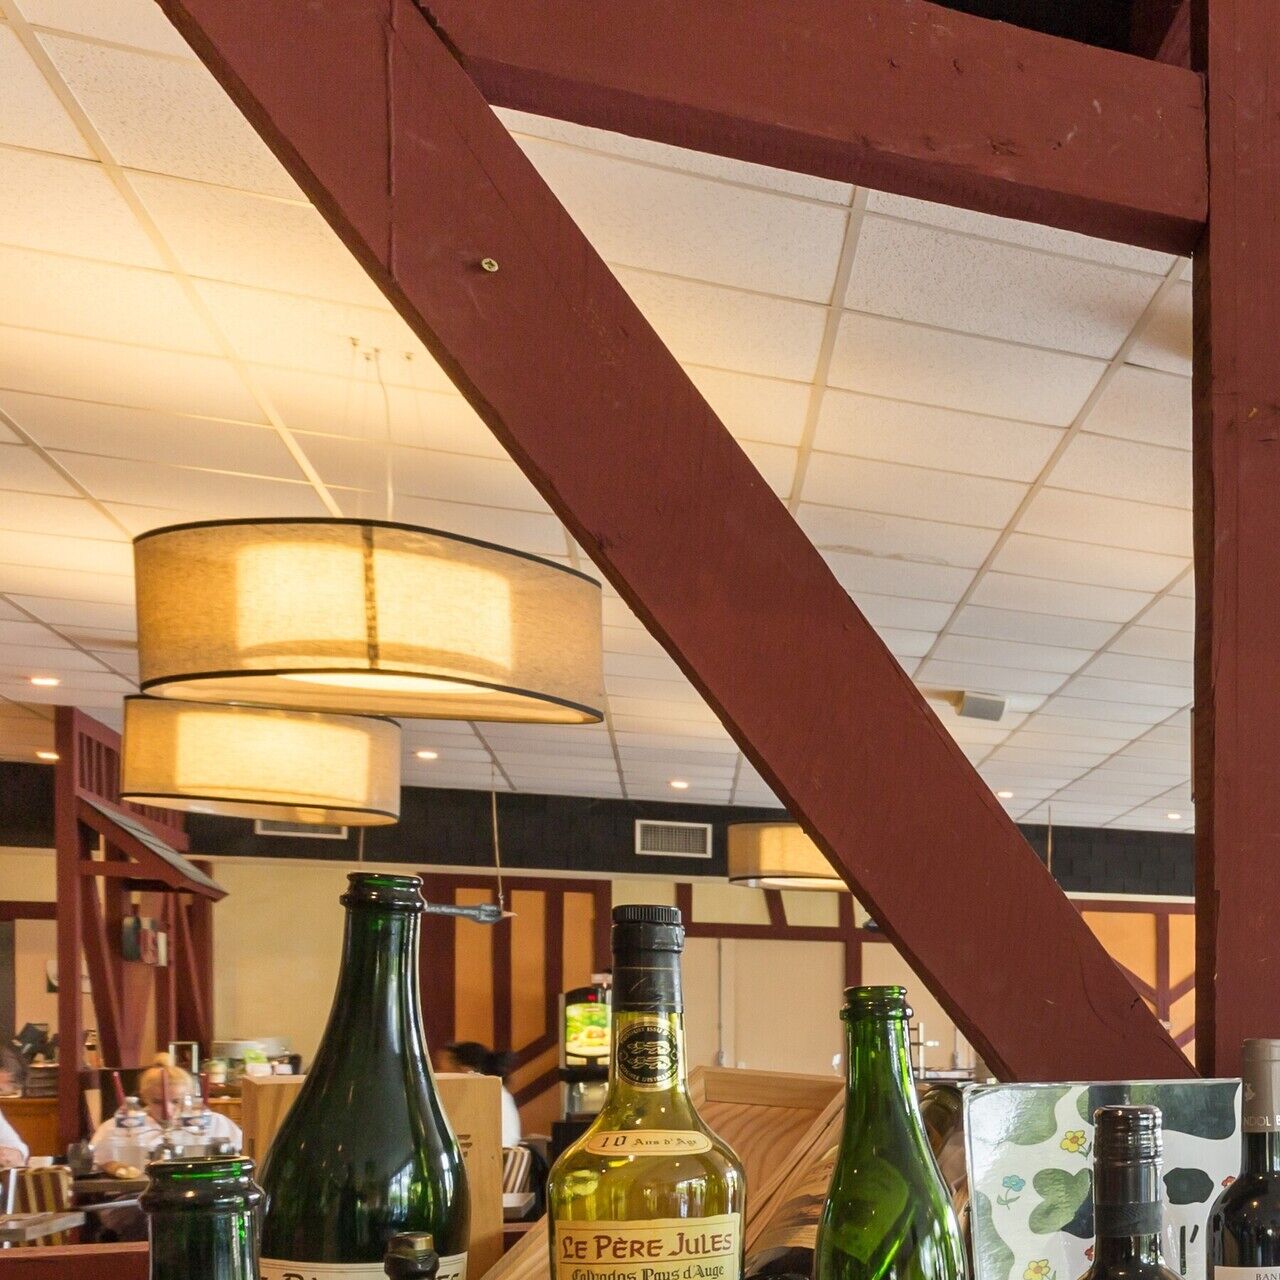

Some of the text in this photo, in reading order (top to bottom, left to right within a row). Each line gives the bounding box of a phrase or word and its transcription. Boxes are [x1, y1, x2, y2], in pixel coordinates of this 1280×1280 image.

[601, 1135, 627, 1148] 10
[562, 1232, 733, 1260] LE PÈRE JULES
